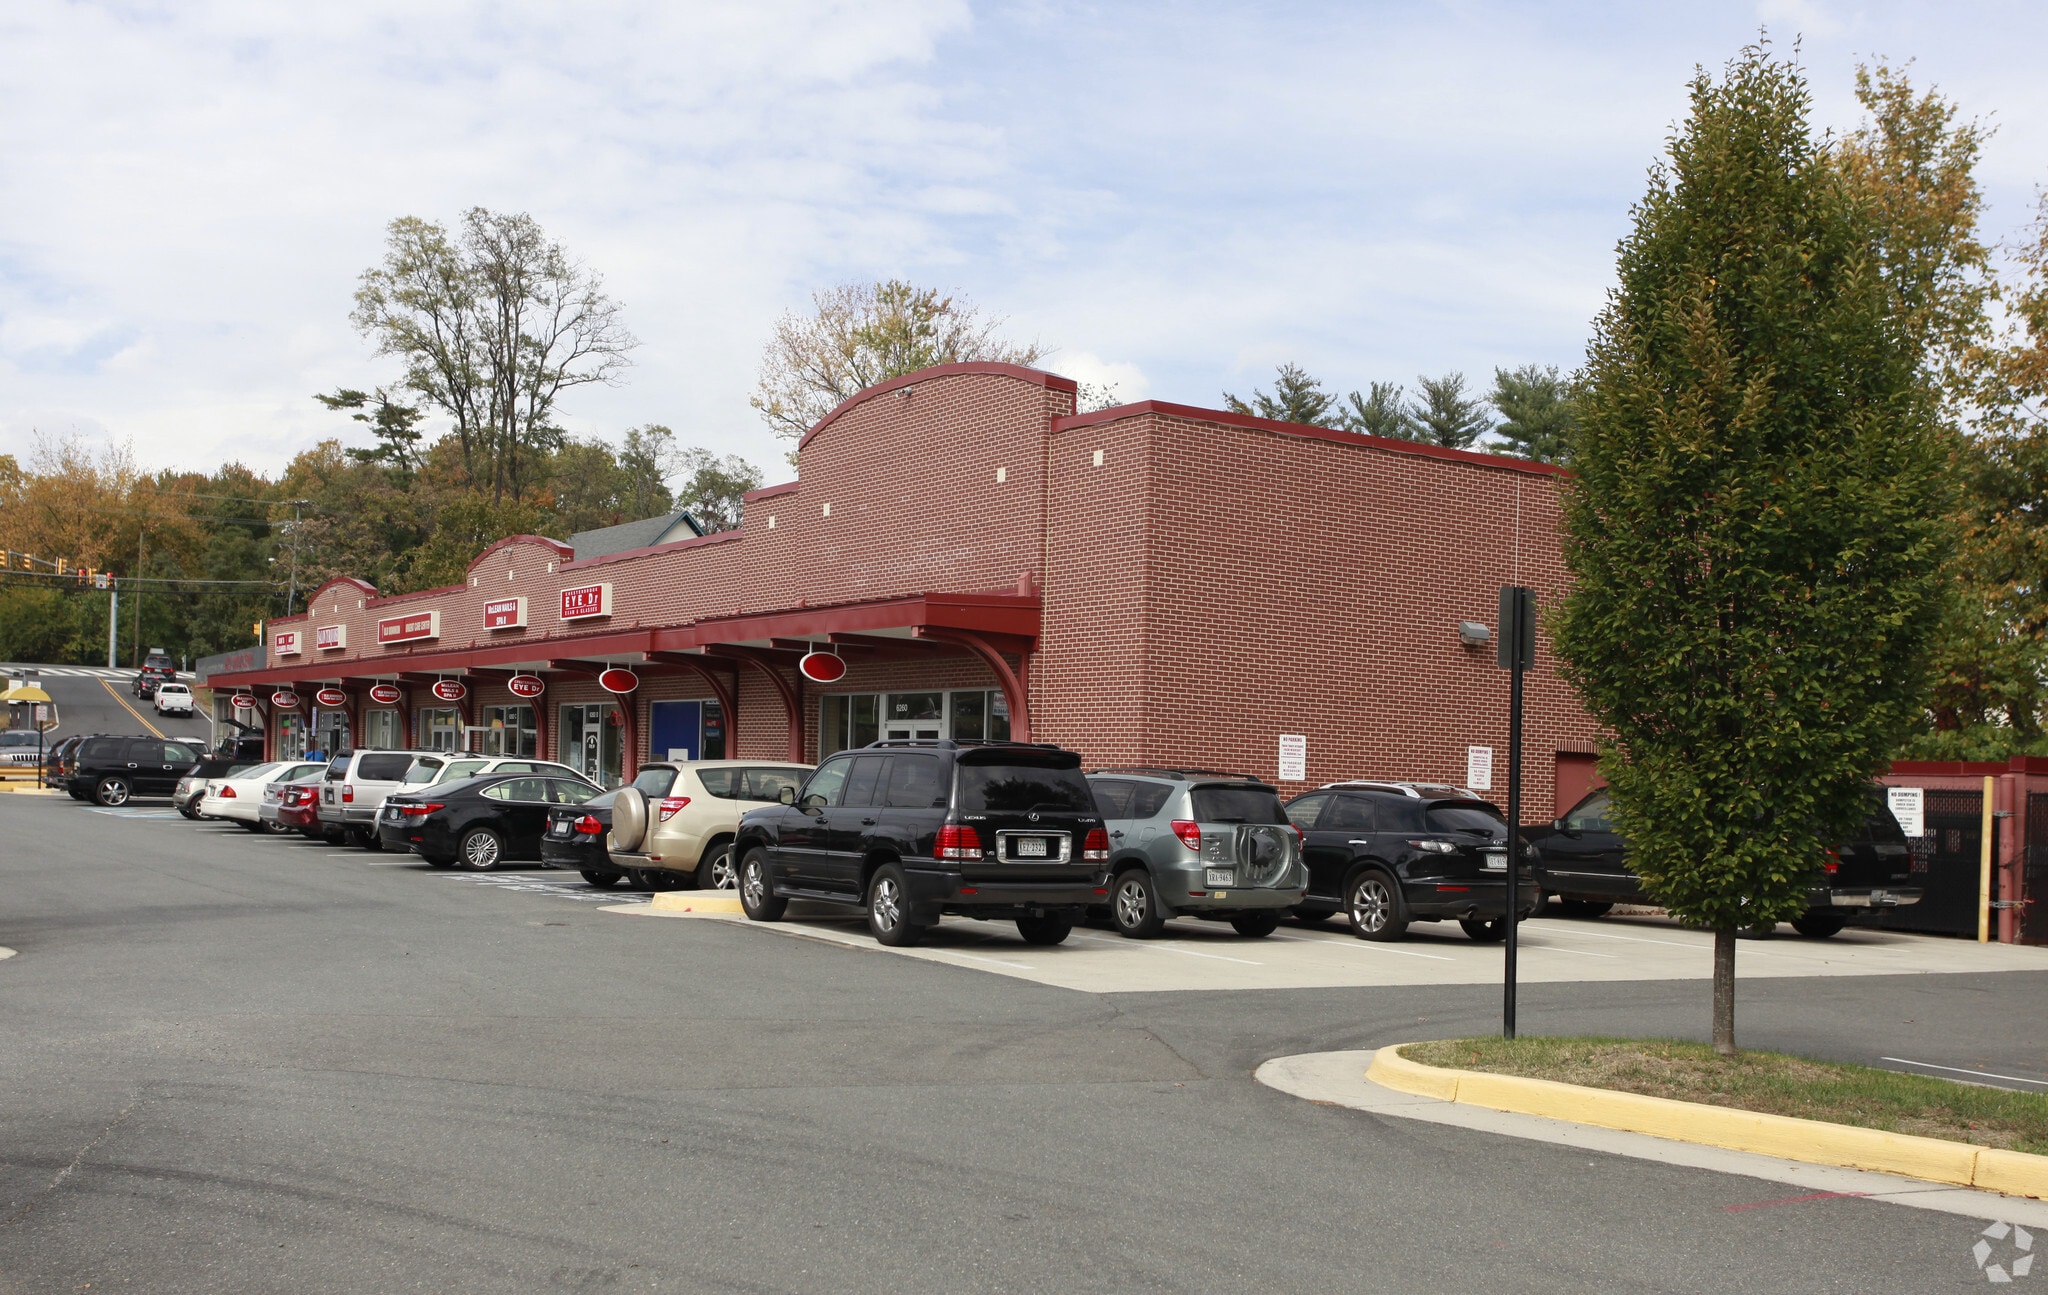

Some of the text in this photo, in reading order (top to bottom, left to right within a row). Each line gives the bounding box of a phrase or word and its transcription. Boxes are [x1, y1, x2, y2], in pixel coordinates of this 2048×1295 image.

[565, 592, 599, 608] EYE Dr
[513, 683, 529, 691] EYE
[895, 703, 909, 712] 6260
